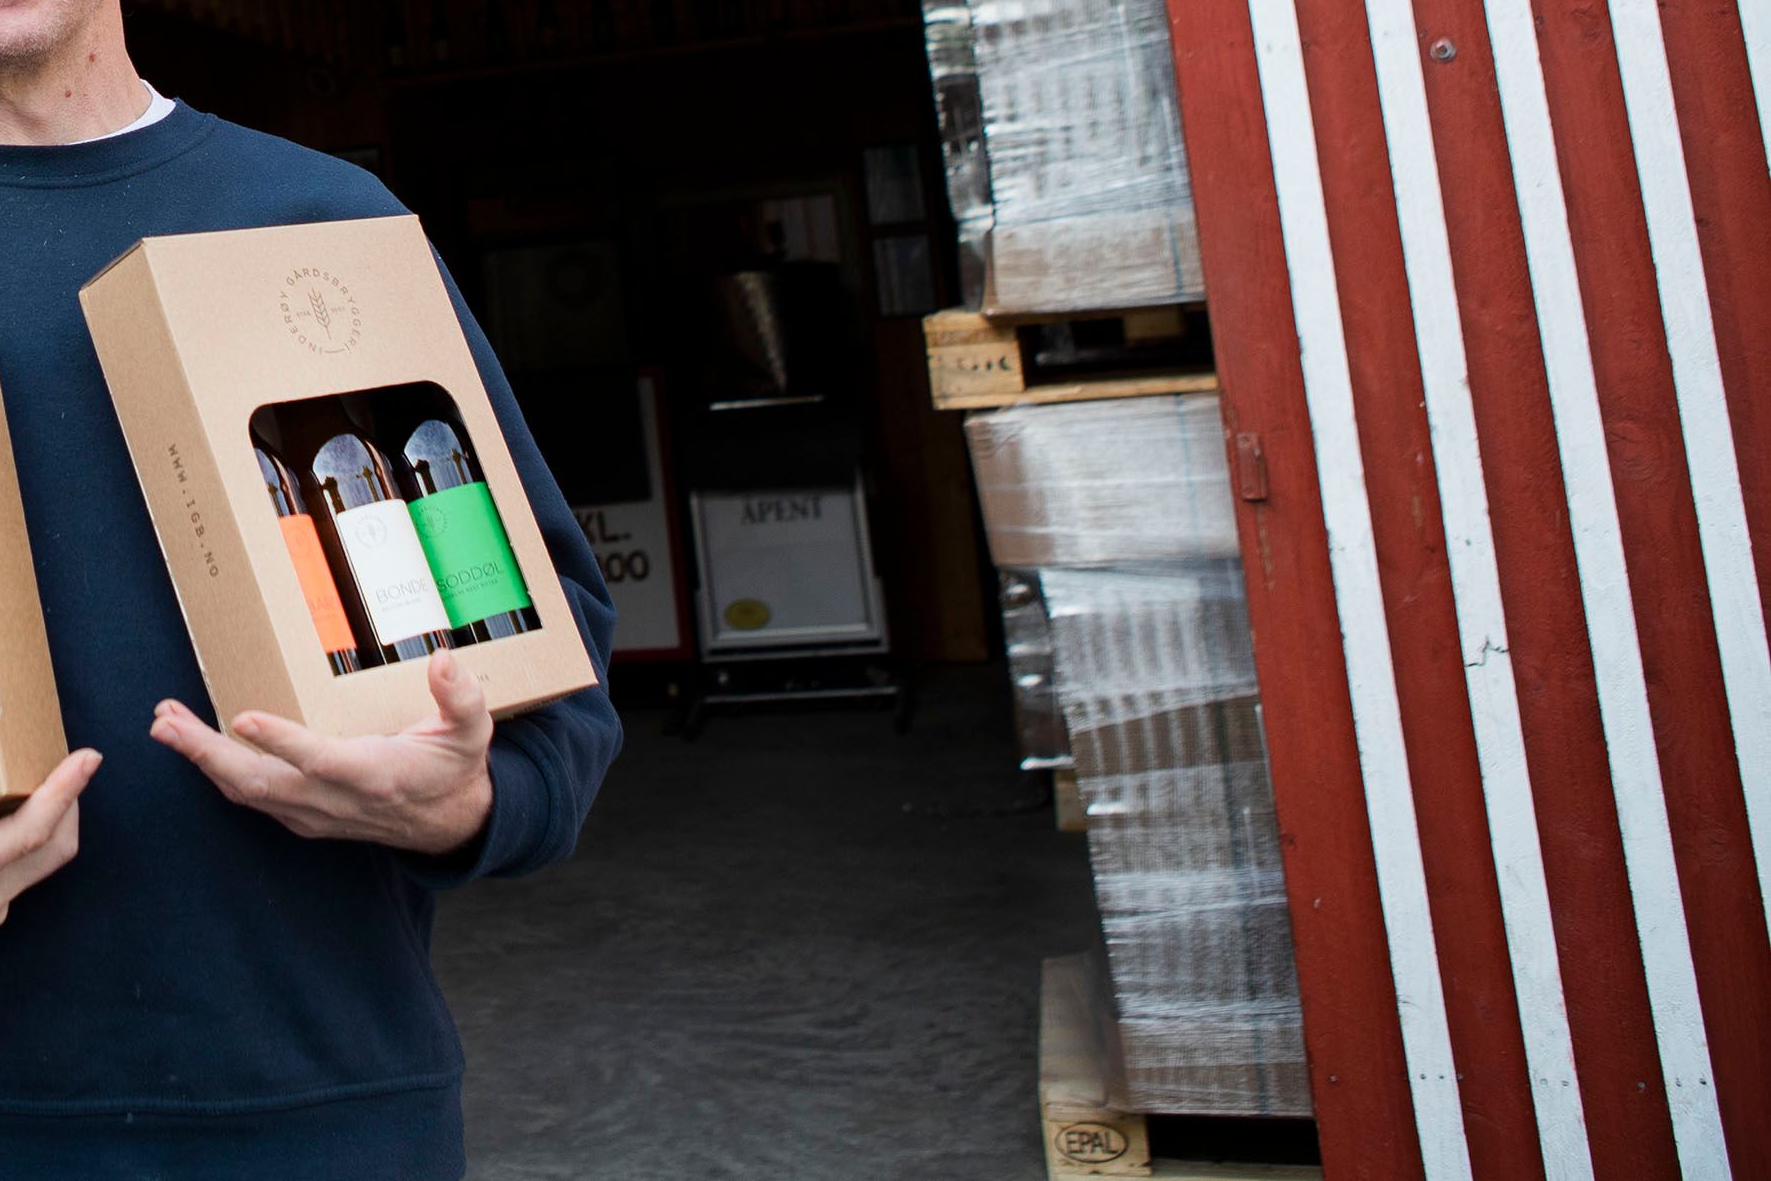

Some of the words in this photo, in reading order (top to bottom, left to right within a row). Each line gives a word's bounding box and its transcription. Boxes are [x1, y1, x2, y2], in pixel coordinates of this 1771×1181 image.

[280, 290, 322, 355] INDERØY
[739, 497, 823, 525] ÅPENT
[436, 562, 505, 593] SODDØL
[594, 549, 650, 583] 00
[375, 579, 428, 604] BONDE
[1065, 1129, 1118, 1155] EPAL
